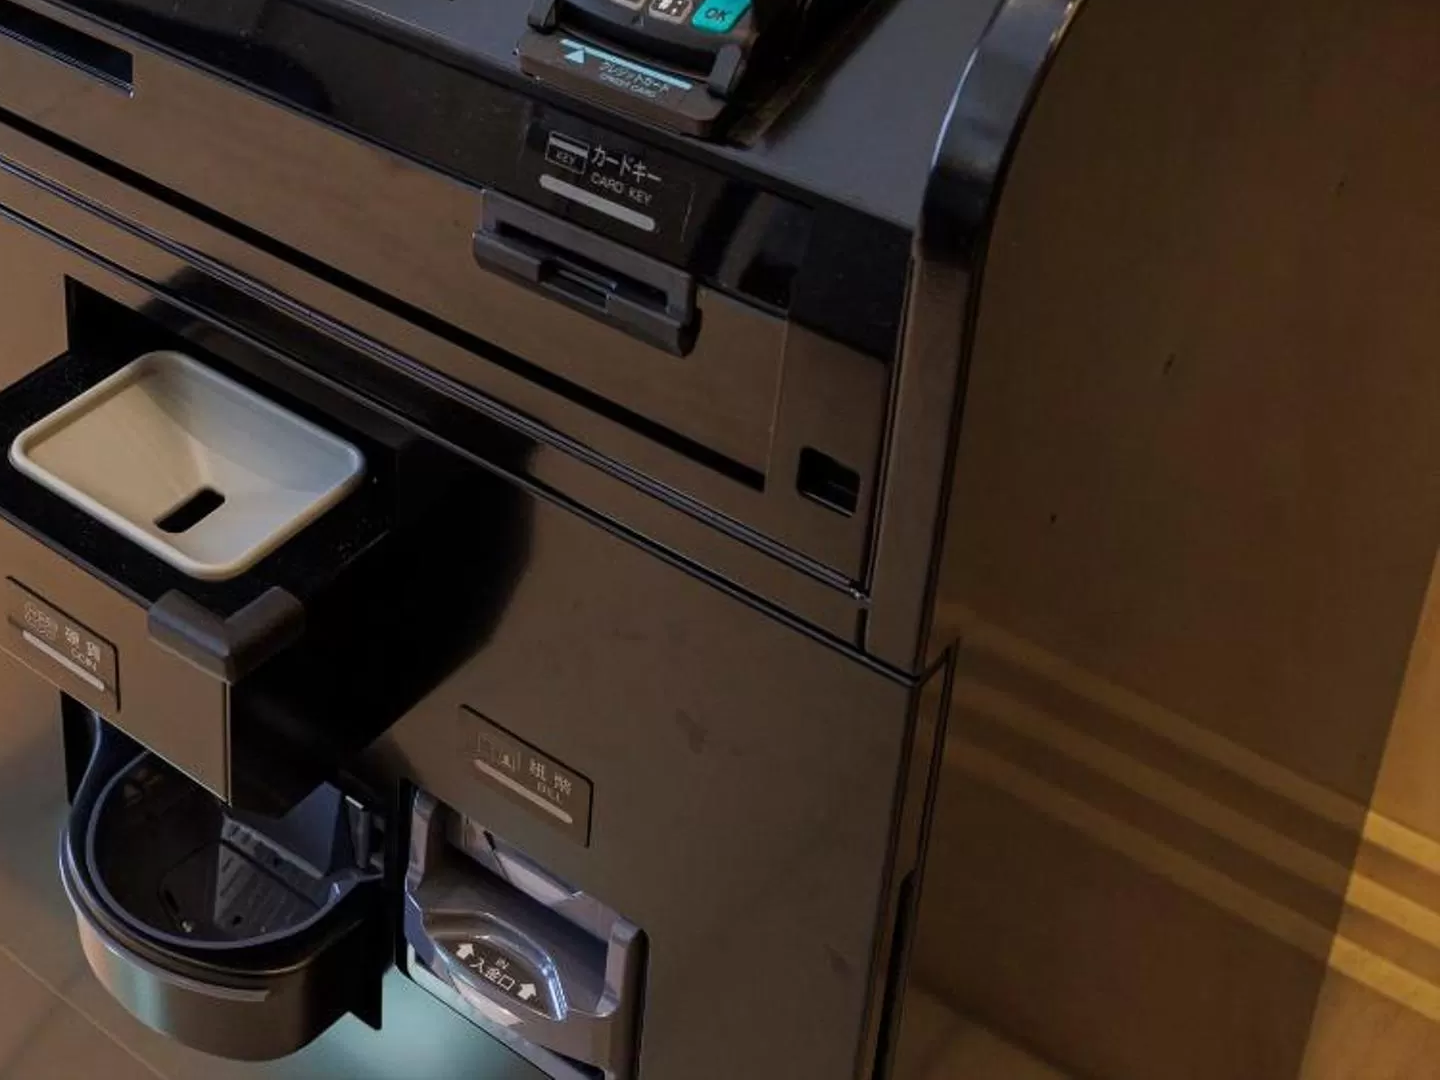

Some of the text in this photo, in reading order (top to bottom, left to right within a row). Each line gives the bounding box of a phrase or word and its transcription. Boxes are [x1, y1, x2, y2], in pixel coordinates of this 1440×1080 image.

[704, 6, 733, 22] OK
[590, 143, 662, 184] カードキー
[590, 171, 653, 207] CARD KEY
[469, 956, 516, 991] 入金口
